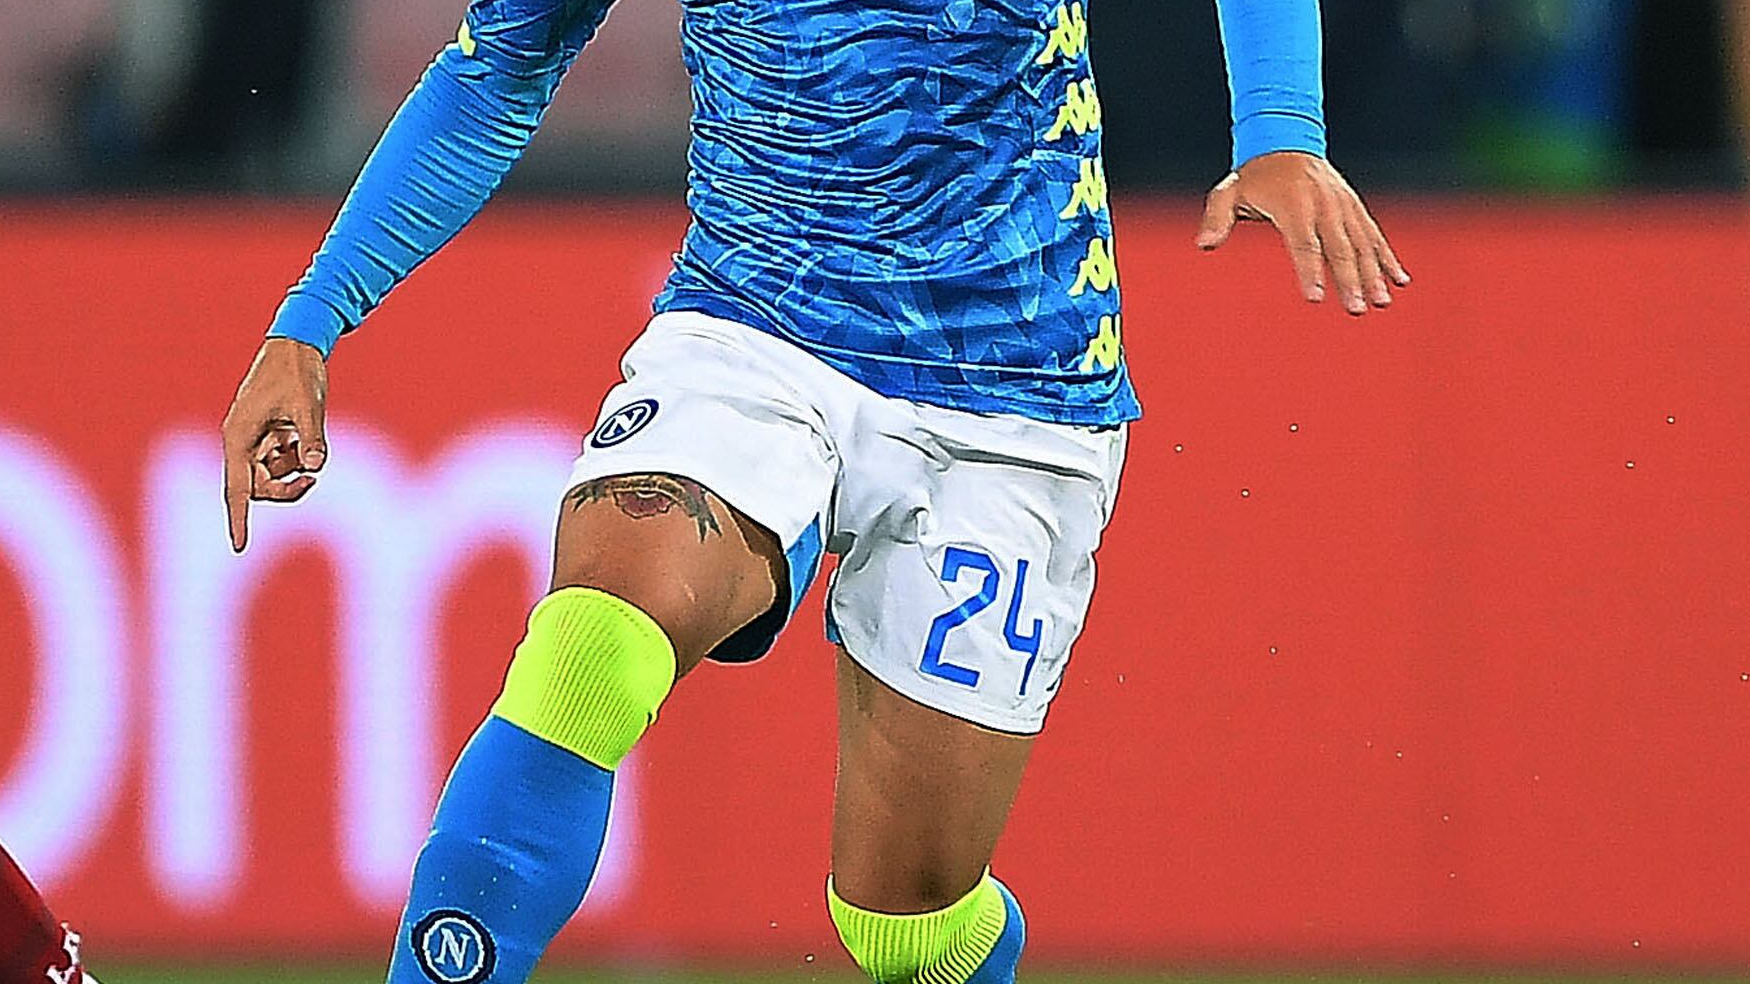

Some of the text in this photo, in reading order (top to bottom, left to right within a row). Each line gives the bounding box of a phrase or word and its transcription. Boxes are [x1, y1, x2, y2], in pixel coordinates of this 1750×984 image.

[602, 408, 645, 439] N
[919, 546, 1043, 696] 24
[434, 927, 470, 970] N
